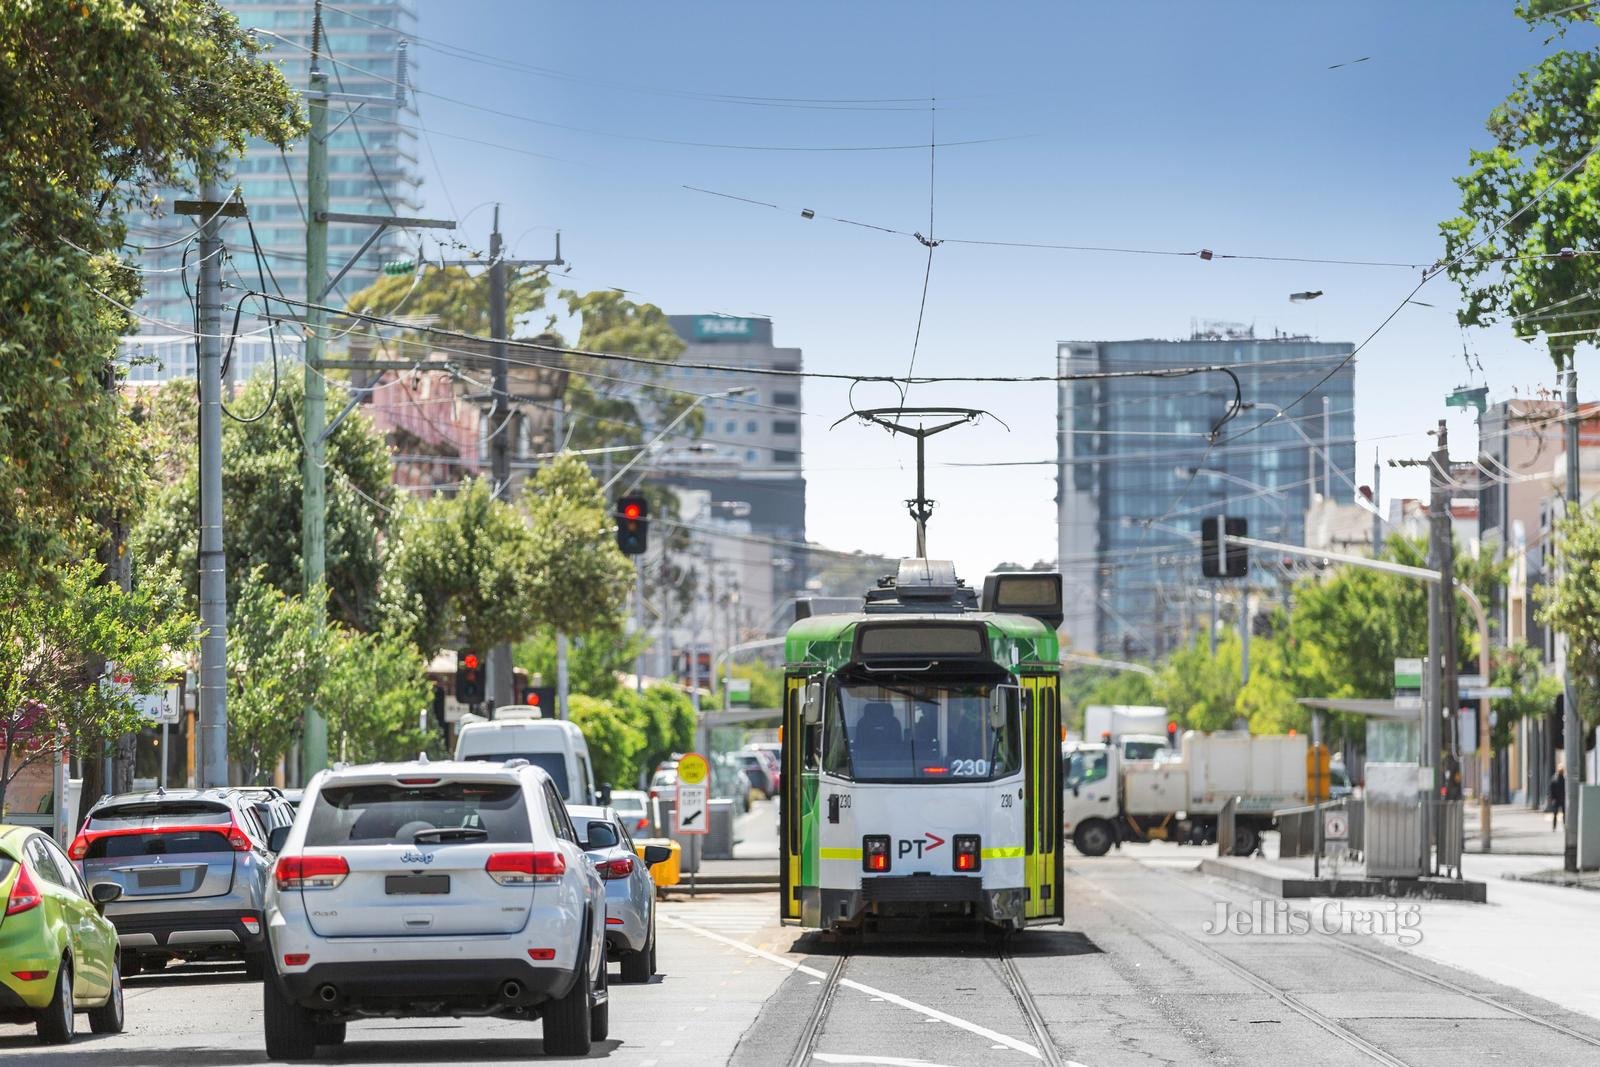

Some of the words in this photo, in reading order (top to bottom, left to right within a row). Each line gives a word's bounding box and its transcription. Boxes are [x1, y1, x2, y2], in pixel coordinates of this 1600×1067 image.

[952, 759, 987, 776] 230
[839, 794, 851, 808] 230
[1000, 794, 1012, 808] 230
[401, 852, 434, 864] Jeep
